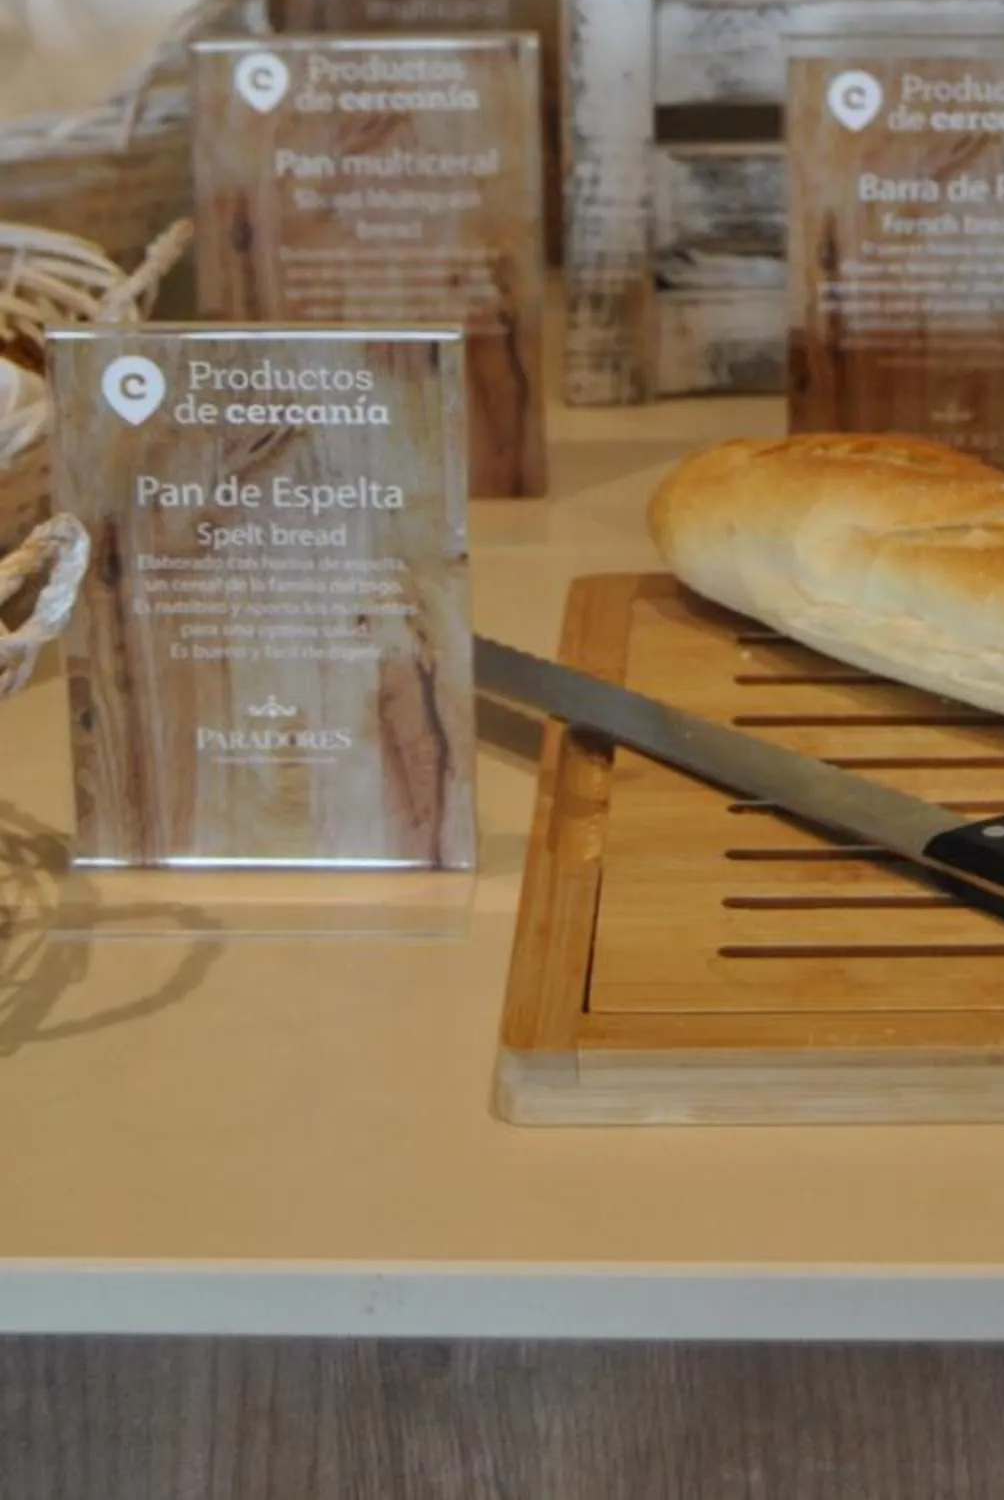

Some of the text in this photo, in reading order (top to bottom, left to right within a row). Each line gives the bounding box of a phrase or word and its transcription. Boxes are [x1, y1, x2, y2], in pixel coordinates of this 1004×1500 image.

[308, 54, 468, 82] Productos
[295, 86, 480, 112] de cercanía
[888, 104, 924, 131] de
[275, 150, 335, 177] Pan
[859, 174, 938, 201] Barra
[946, 174, 989, 202] de
[189, 360, 374, 391] Productos
[174, 395, 389, 426] de cercanía
[137, 475, 404, 515] Pan de Espelta
[198, 522, 347, 549] Spelt bread
[197, 727, 352, 749] PARADORES
